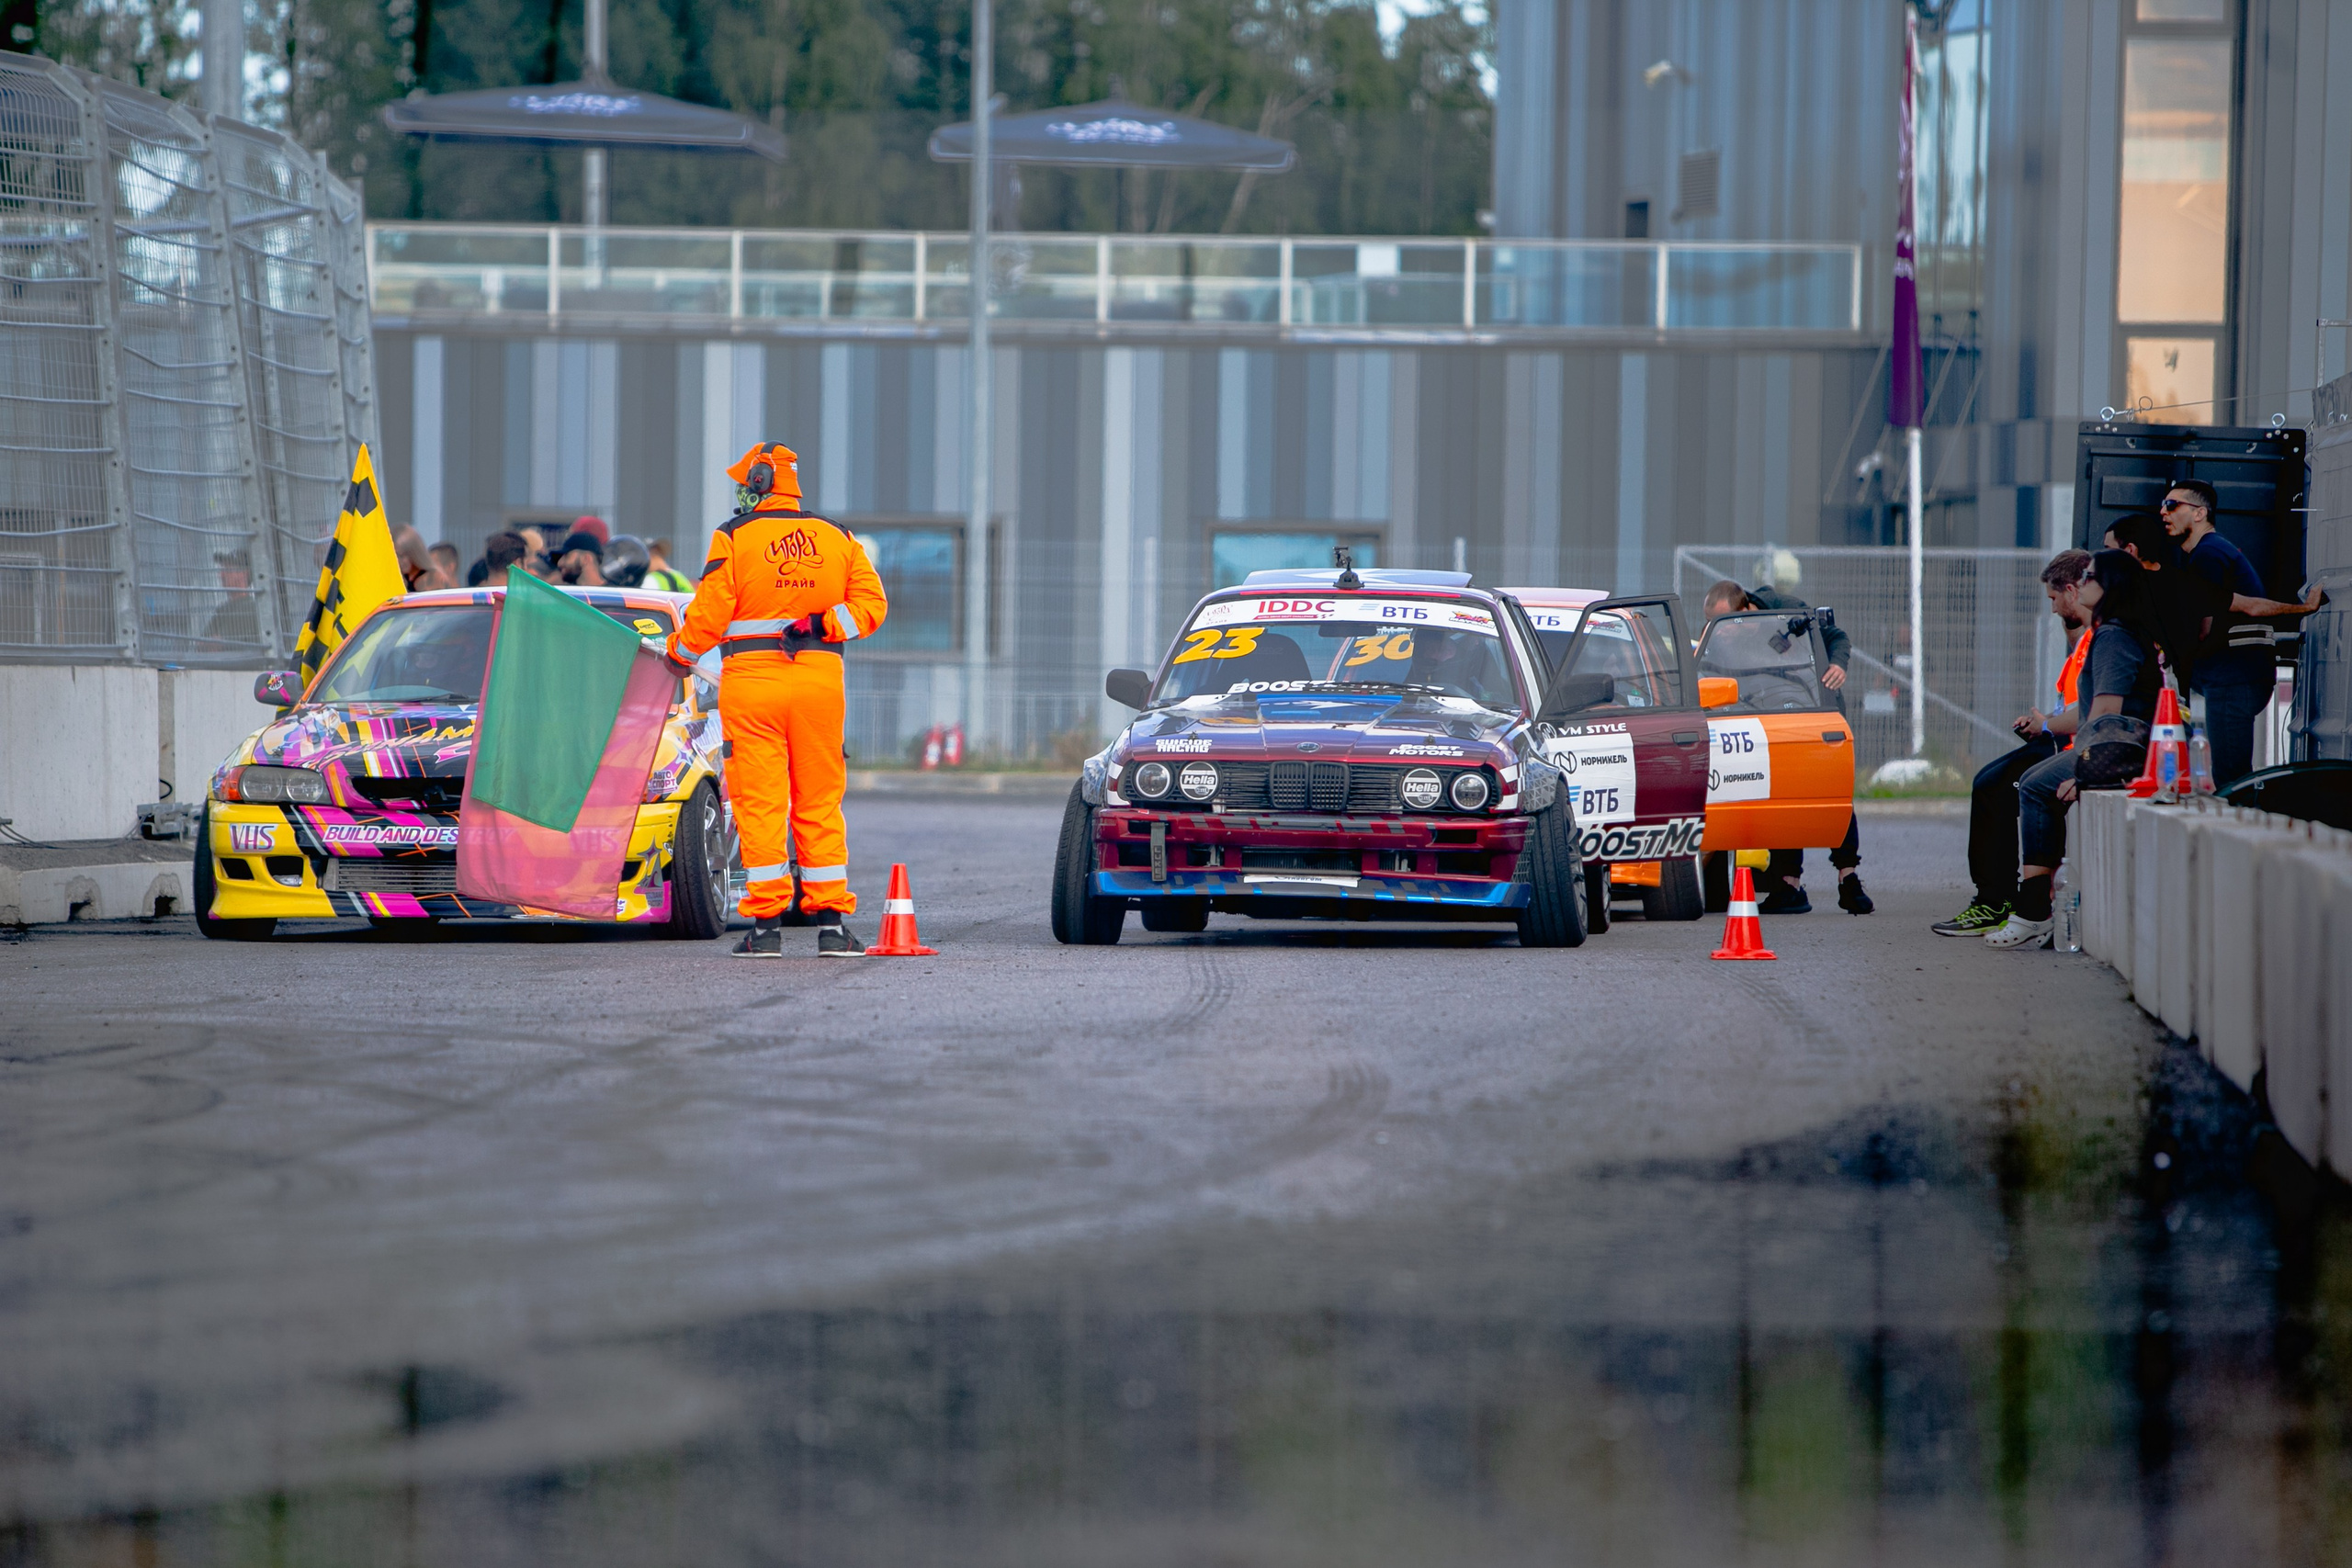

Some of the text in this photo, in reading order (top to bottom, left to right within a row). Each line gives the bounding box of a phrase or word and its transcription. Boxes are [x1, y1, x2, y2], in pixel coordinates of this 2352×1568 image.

[775, 578, 816, 589] ДРАЙВ
[1258, 601, 1336, 614] IDDC
[1382, 606, 1428, 620] ВТБ
[1174, 627, 1266, 665] 23
[1344, 633, 1415, 667] 30
[1558, 722, 1627, 736] VM STYLE
[1398, 743, 1461, 751] BOOST
[1720, 731, 1754, 754] ВТБ
[1388, 749, 1464, 757] MOTORS
[1580, 754, 1628, 766] НОРНИКЕЛЬ
[1182, 774, 1216, 785] Hella
[1723, 772, 1765, 784] НОРНИКЕЛЬ
[1406, 783, 1440, 793] Hella
[1582, 787, 1619, 815] ВТБ
[231, 824, 277, 852] VHS
[324, 825, 379, 842] BUILD
[383, 826, 422, 842] AND
[1578, 819, 1706, 860] OOSTMO
